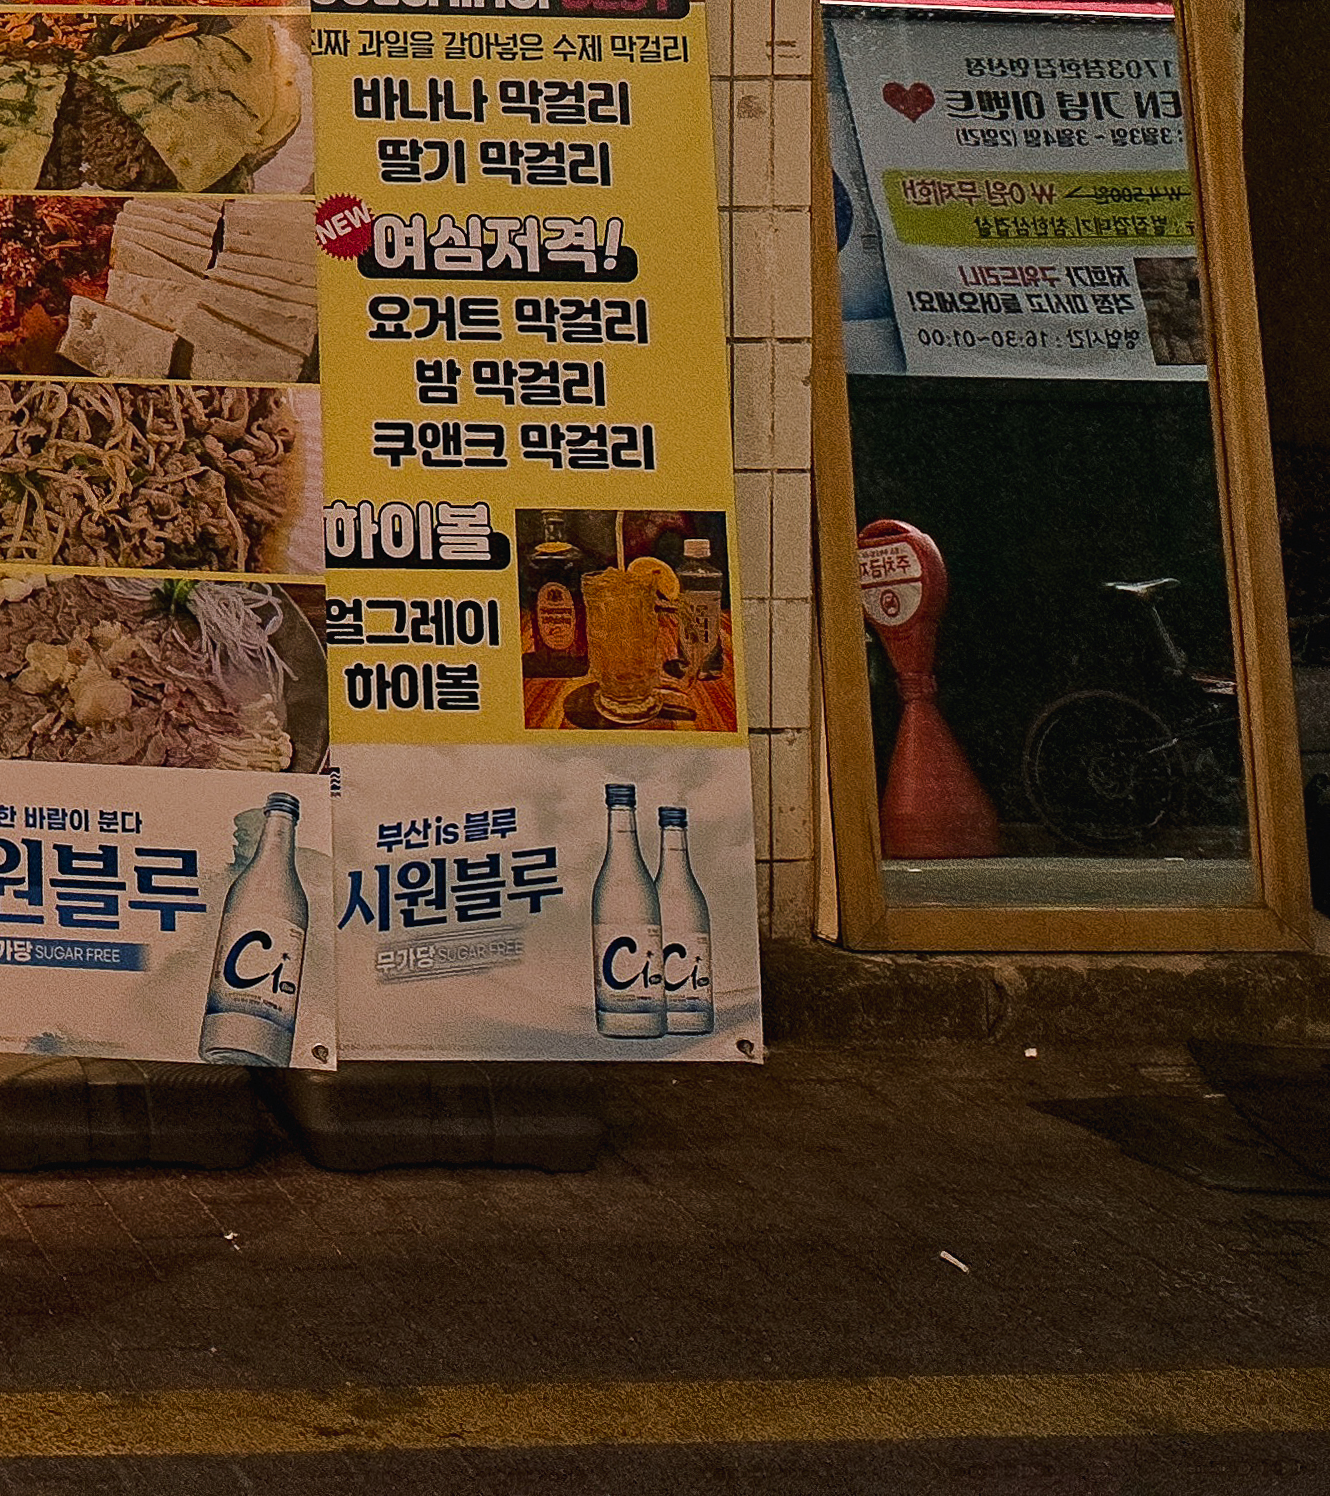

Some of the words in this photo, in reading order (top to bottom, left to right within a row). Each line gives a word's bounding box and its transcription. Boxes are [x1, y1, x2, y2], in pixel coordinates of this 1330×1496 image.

[357, 29, 435, 60] 과일을
[443, 30, 543, 62] 갈아넣은
[552, 33, 603, 63] 수제
[611, 35, 689, 64] 막걸리
[353, 77, 489, 123] 바나나
[498, 79, 631, 125] 막걸리
[378, 138, 466, 185] 딸기
[479, 140, 612, 186] 막걸리
[316, 202, 372, 245] NEW
[373, 213, 624, 274] 여심저격!
[367, 295, 503, 342] 요거트
[514, 297, 650, 344] 막걸리
[415, 359, 462, 404] 밤
[472, 361, 607, 407] 막걸리
[373, 421, 508, 467] 쿠앤크
[519, 424, 656, 470] 막걸리
[324, 500, 493, 562] 하이볼
[325, 598, 500, 646] 얼그레이
[344, 663, 481, 711] 하이볼
[25, 806, 90, 832] 바람이
[97, 809, 143, 835] 분다
[376, 817, 432, 853] 부산
[434, 815, 460, 847] is
[463, 806, 518, 845] 블루
[337, 845, 565, 934] 시원블루
[35, 944, 84, 962] SUGAR
[86, 946, 121, 964] FREE
[376, 944, 437, 974] 무가당
